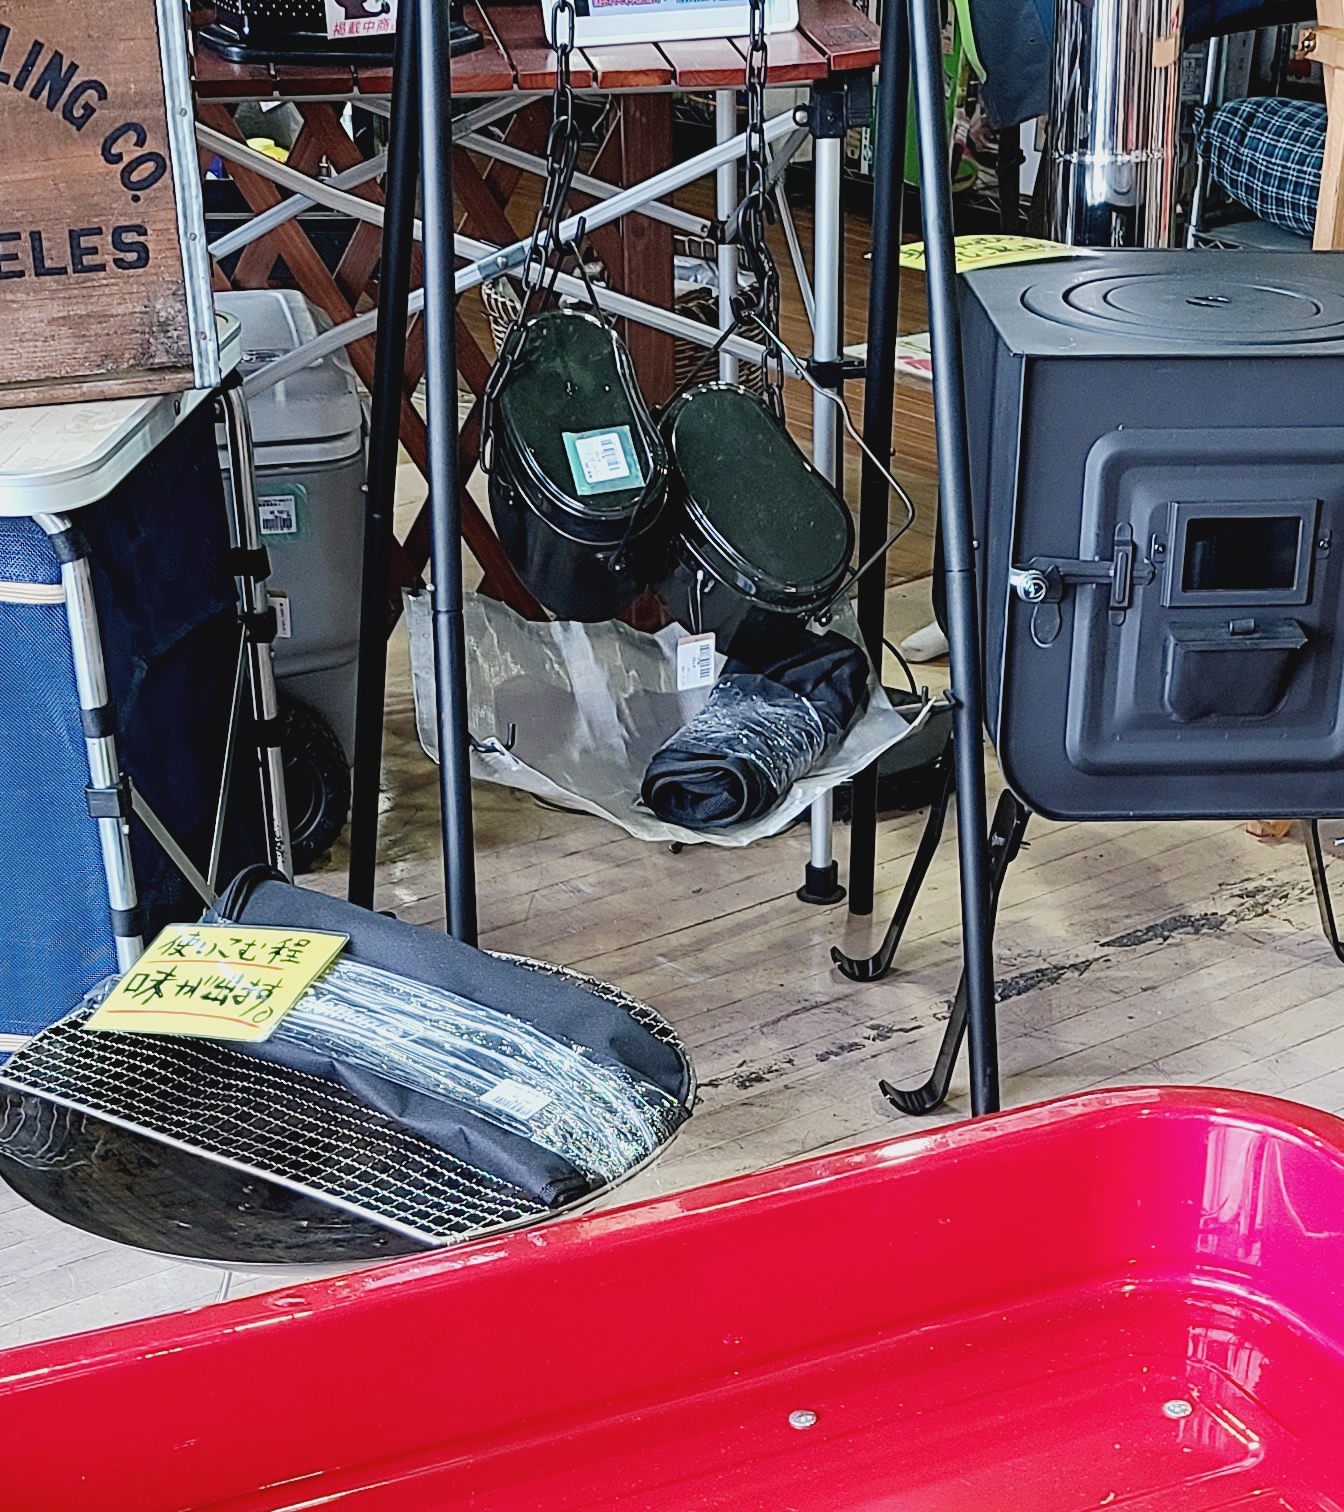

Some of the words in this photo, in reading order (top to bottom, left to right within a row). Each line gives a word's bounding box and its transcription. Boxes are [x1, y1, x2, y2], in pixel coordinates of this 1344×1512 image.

[333, 18, 396, 37] 掲載中商
[101, 122, 167, 203] CO.
